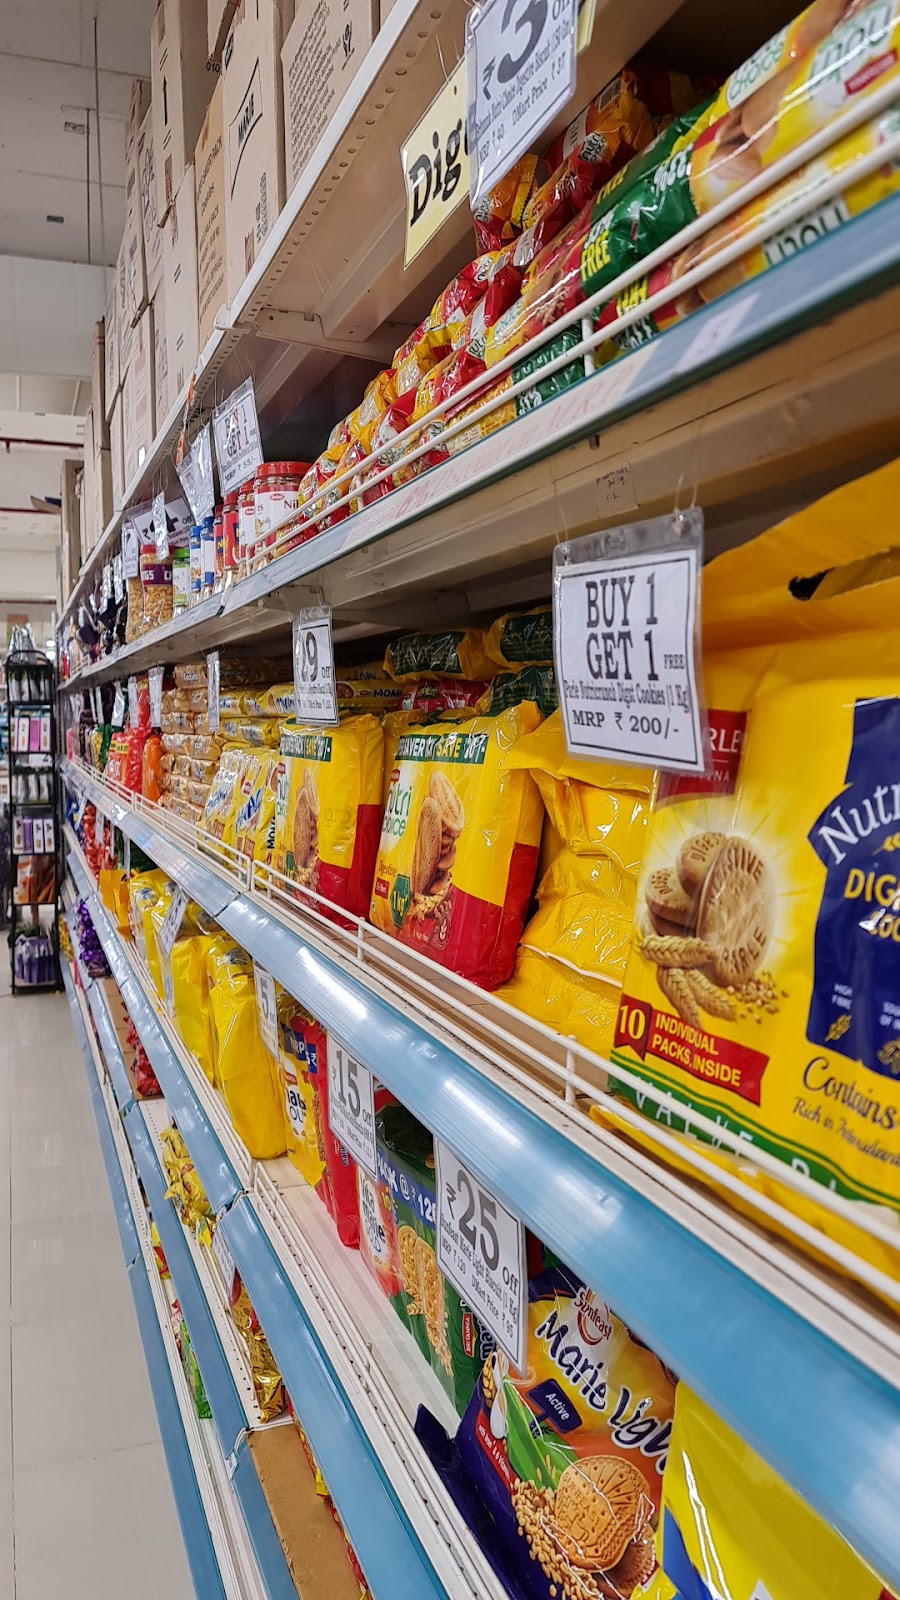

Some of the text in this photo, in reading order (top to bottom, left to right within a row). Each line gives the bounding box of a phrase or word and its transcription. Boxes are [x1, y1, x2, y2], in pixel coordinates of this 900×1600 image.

[580, 229, 611, 282] FREE
[284, 500, 299, 509] Nil
[585, 571, 658, 628] BUY 1
[586, 629, 685, 681] GET 1 FREE
[636, 683, 666, 706] Cookies
[572, 709, 605, 728] MRP
[629, 715, 679, 739] 200/-
[709, 728, 741, 753] RLE
[844, 867, 900, 908] DIG
[619, 1005, 646, 1040] 10
[655, 1013, 719, 1056] INDIVIDUAL
[336, 1050, 361, 1118] 15
[803, 1056, 899, 1130] Contains
[399, 1172, 410, 1201] @
[457, 1168, 500, 1272] 25
[502, 1266, 519, 1297] Off
[486, 1294, 500, 1320] Price
[574, 1290, 613, 1340] Sunfeast
[464, 1317, 472, 1353] BRITANNIA
[536, 1310, 608, 1411] Marie
[545, 1392, 570, 1421] Active
